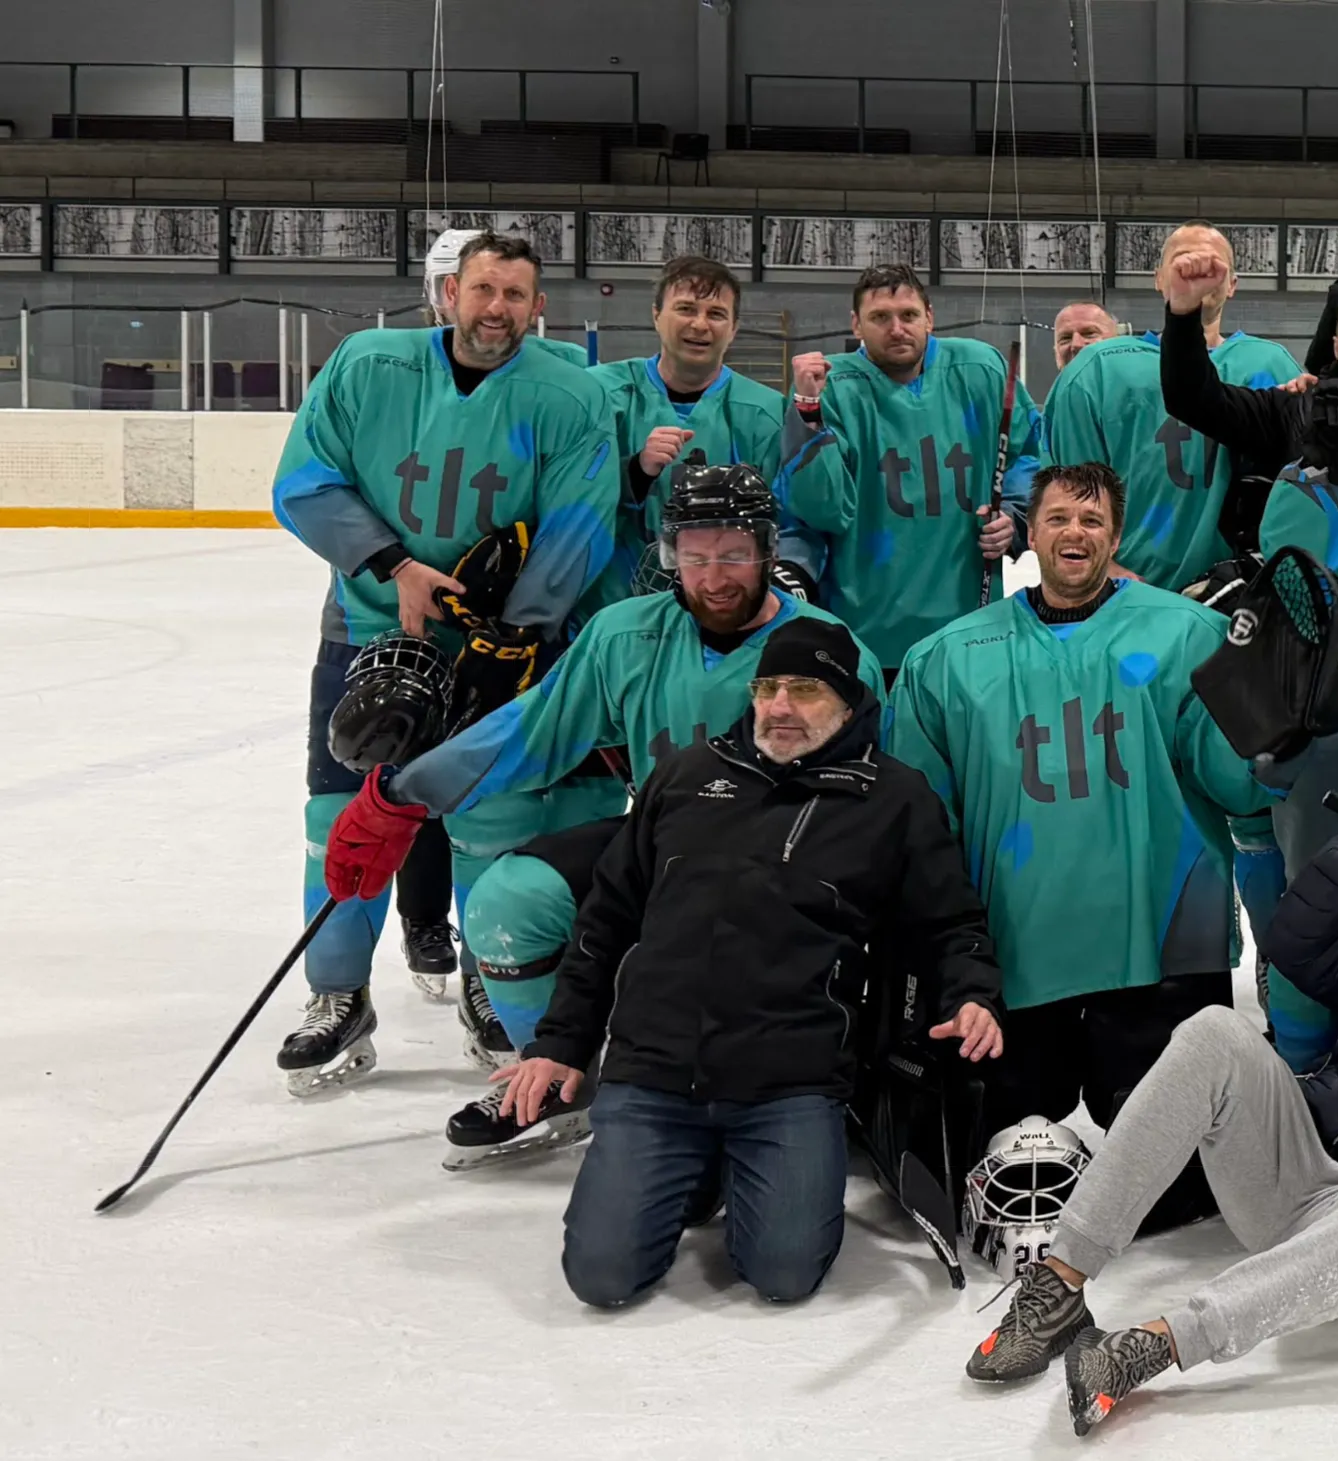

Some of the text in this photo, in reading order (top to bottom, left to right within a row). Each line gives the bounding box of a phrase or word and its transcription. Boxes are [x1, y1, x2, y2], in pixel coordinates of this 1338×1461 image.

[879, 434, 974, 518] tlt
[993, 432, 1009, 494] CCM
[1155, 416, 1220, 490] tl
[394, 447, 509, 539] tlt
[962, 630, 1016, 648] TACKLA
[1015, 696, 1130, 804] tlt
